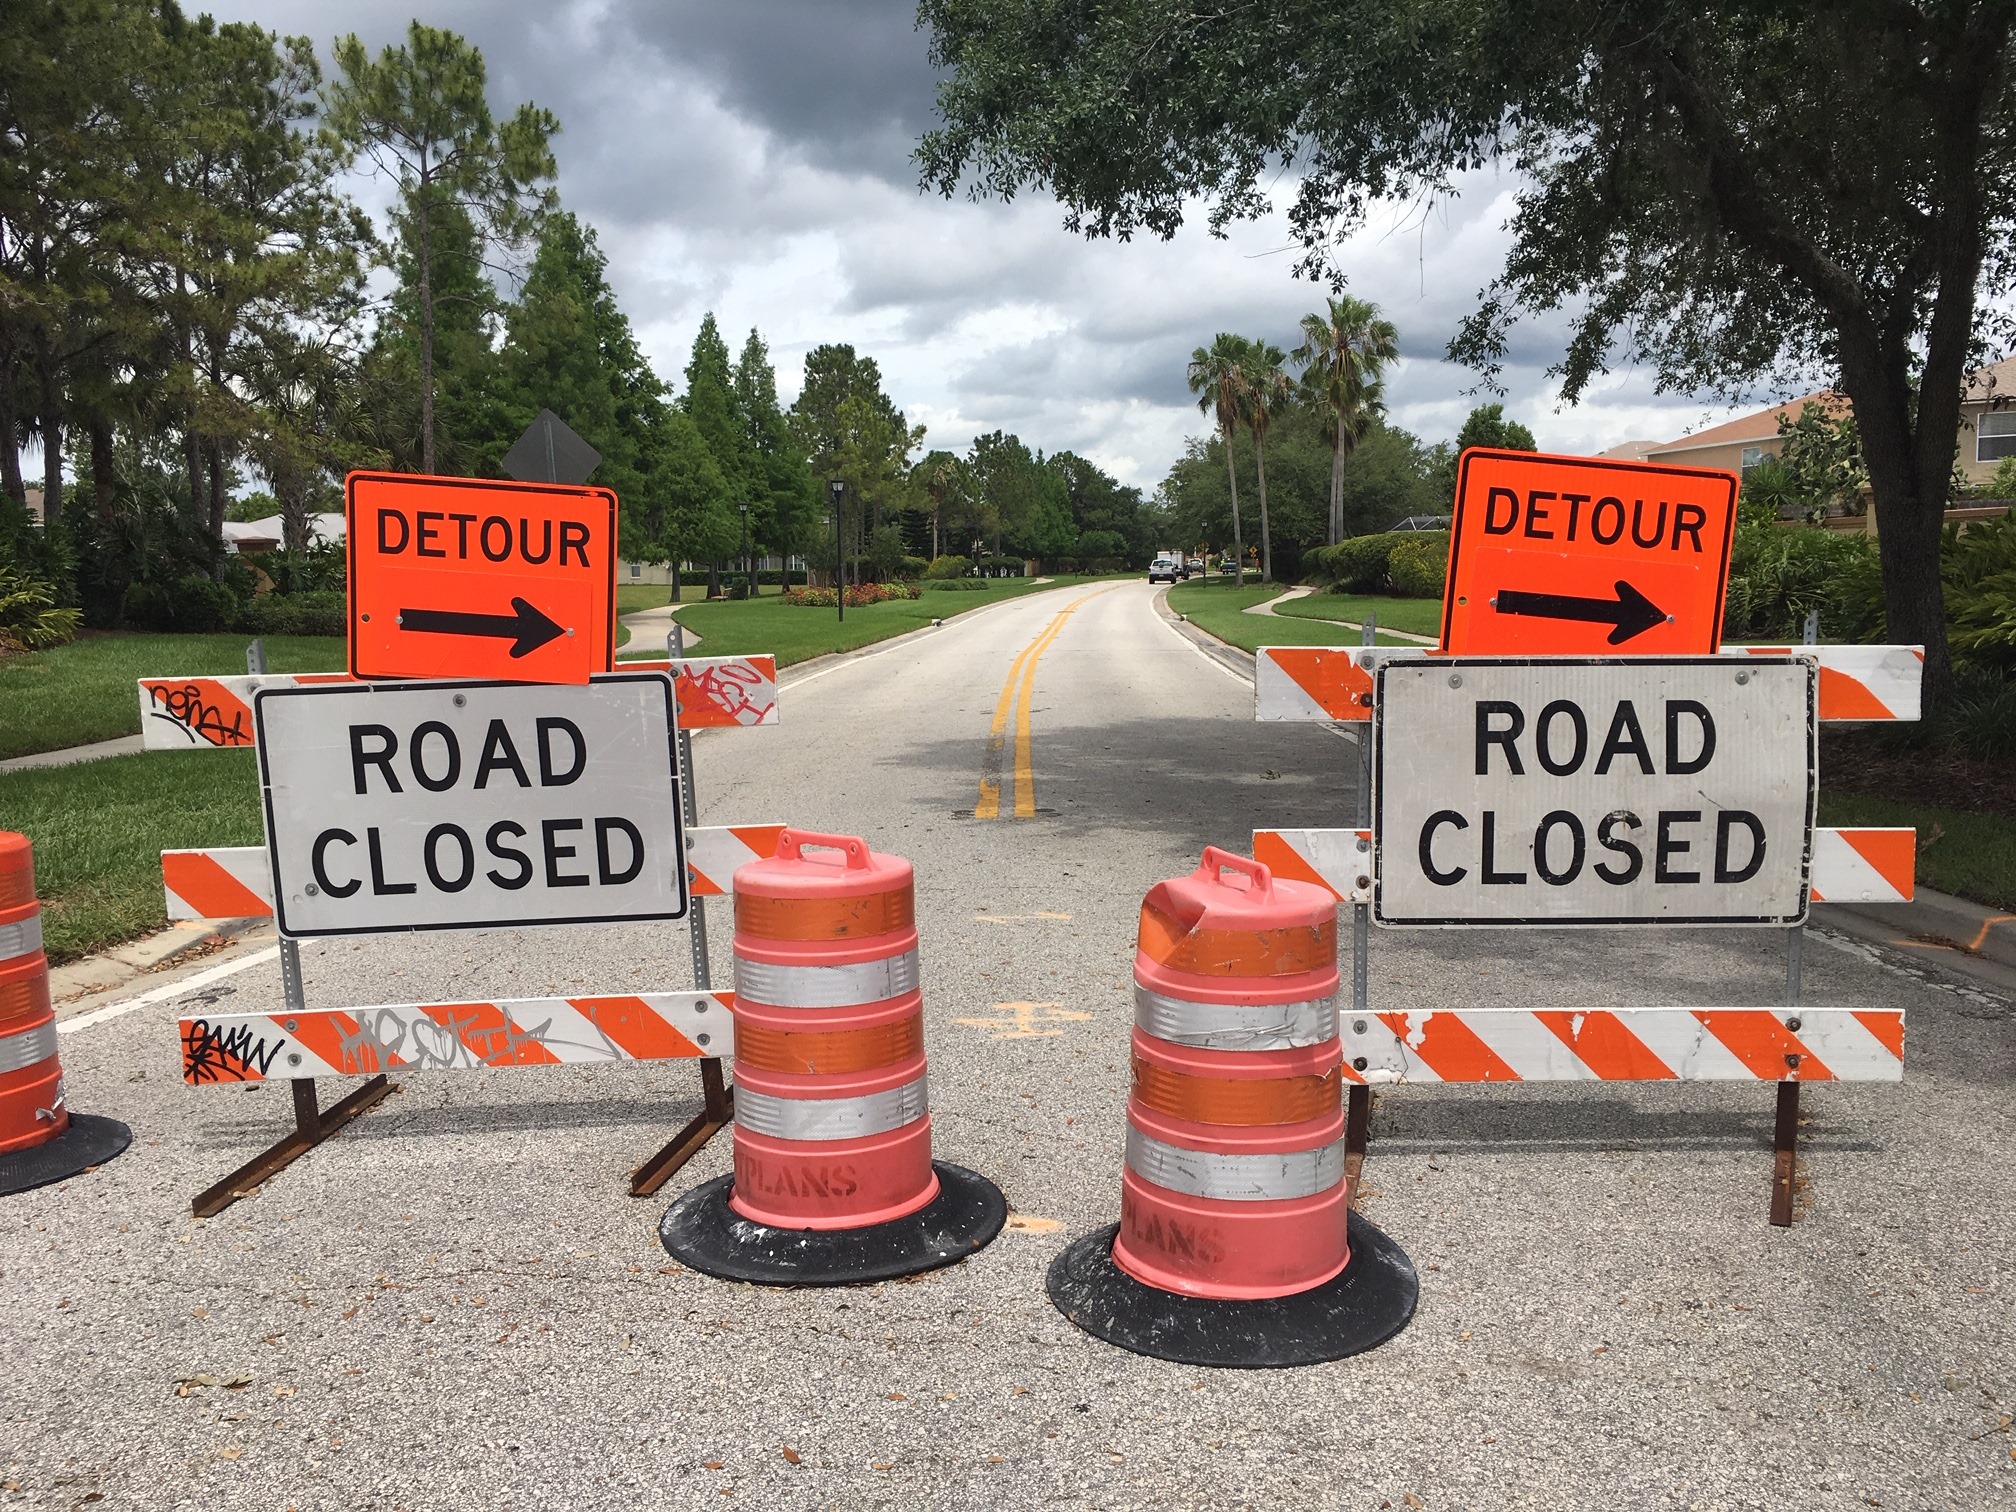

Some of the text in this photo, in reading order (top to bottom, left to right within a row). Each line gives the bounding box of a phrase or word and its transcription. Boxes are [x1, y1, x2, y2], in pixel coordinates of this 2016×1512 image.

[378, 509, 589, 567] DETOUR
[1485, 488, 1705, 552] DETOUR
[349, 717, 586, 794] ROAD
[1475, 700, 1716, 776] ROAD
[312, 817, 644, 898] CLOSED
[1419, 810, 1766, 886] CLOSED
